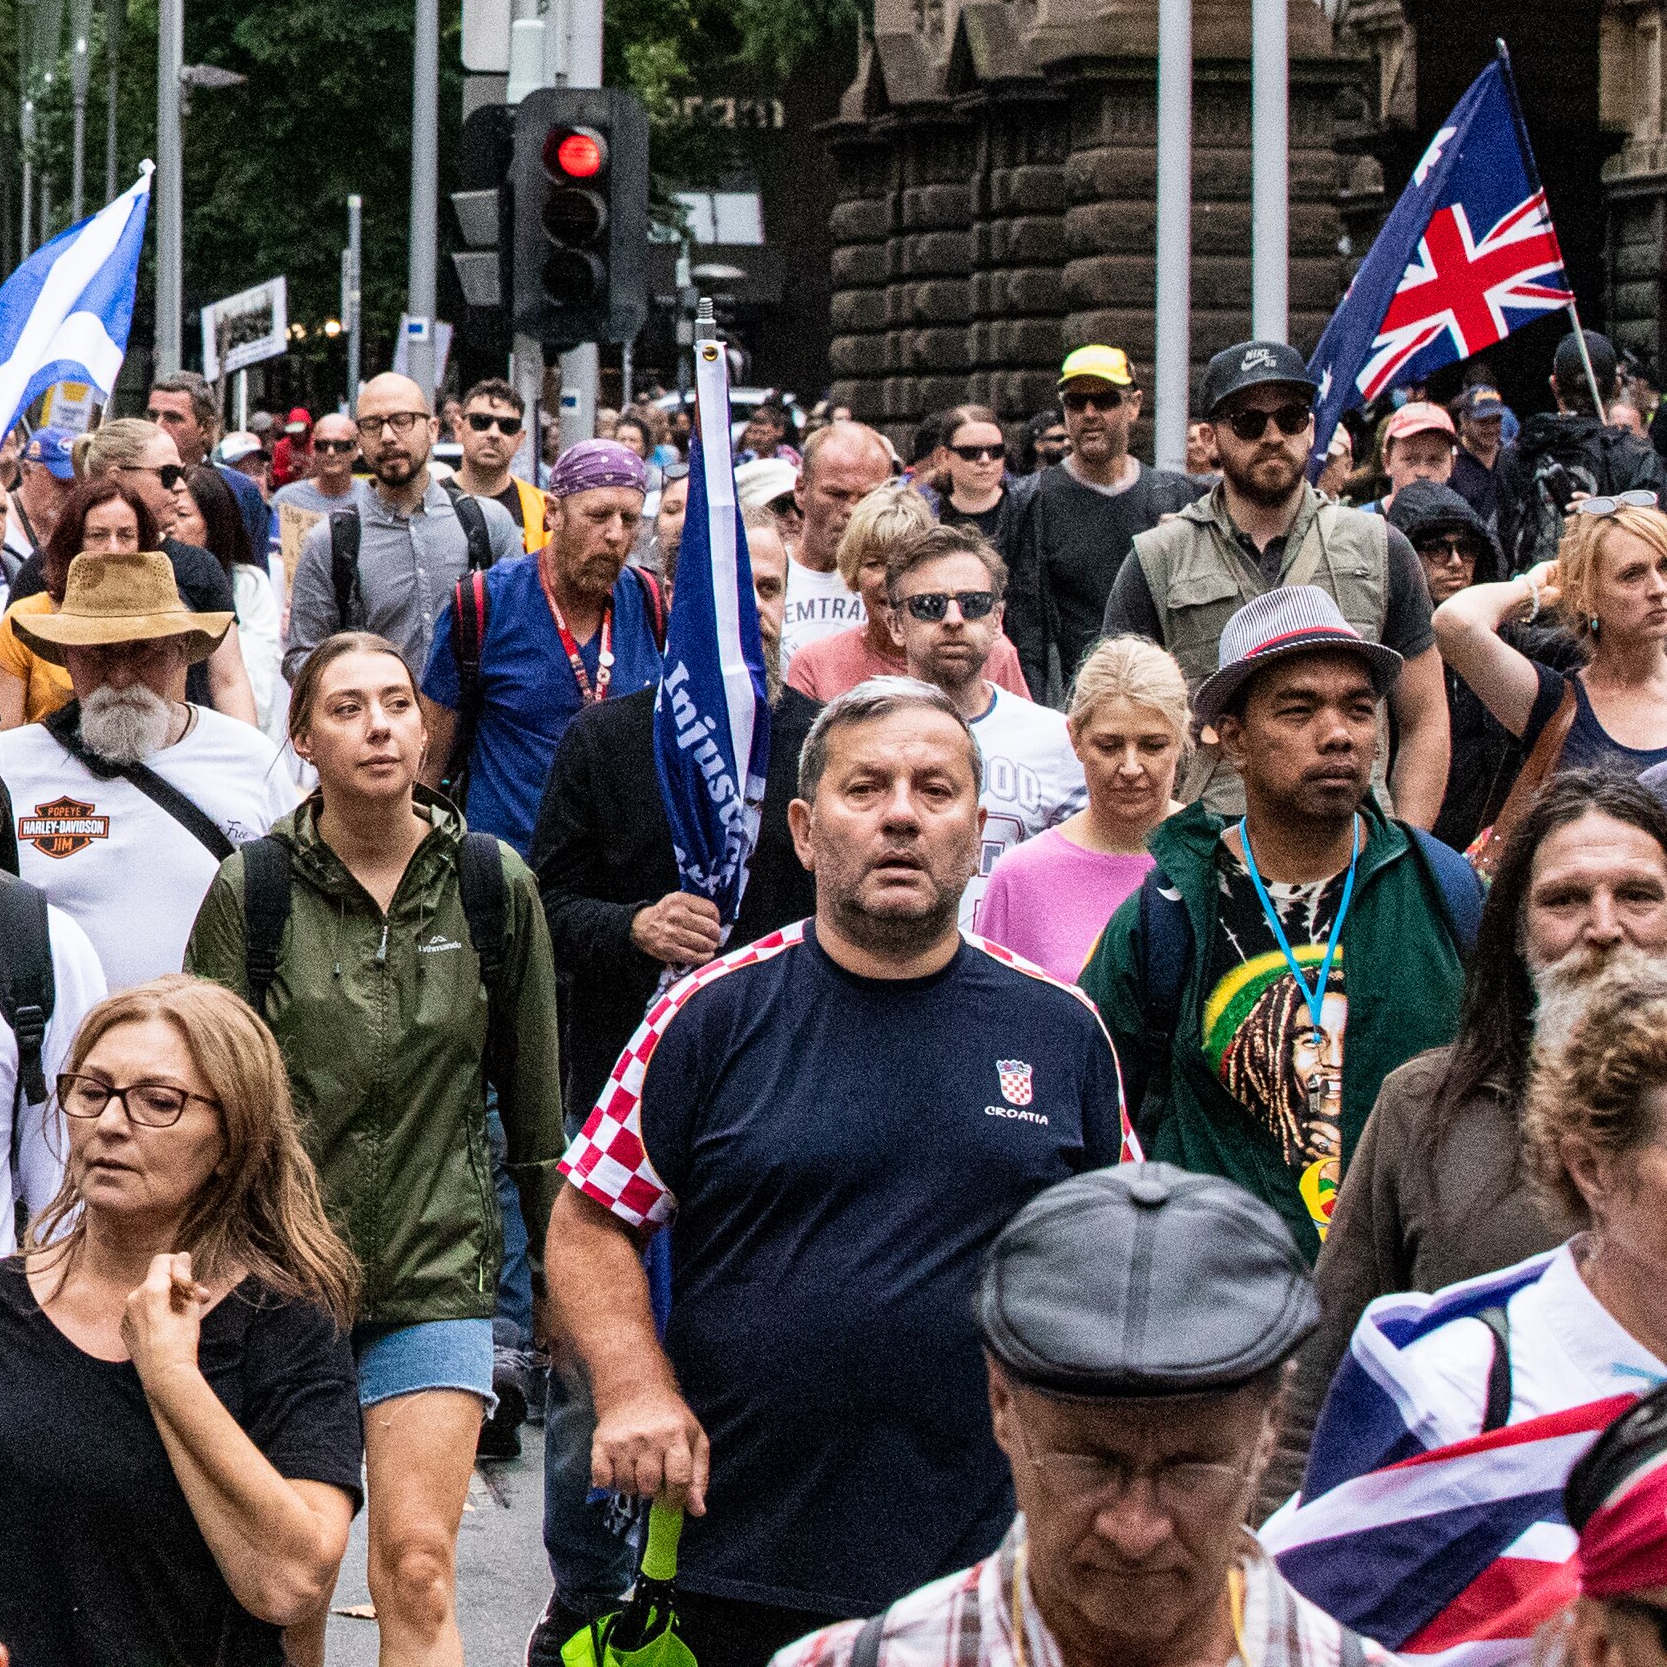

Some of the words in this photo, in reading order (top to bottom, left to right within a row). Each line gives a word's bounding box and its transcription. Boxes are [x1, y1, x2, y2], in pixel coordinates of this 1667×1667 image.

[47, 806, 82, 816] POPEYE
[23, 819, 105, 835] HARLEY-DAVIDSON
[50, 837, 73, 852] JIM
[984, 1105, 1049, 1126] CROATIA
